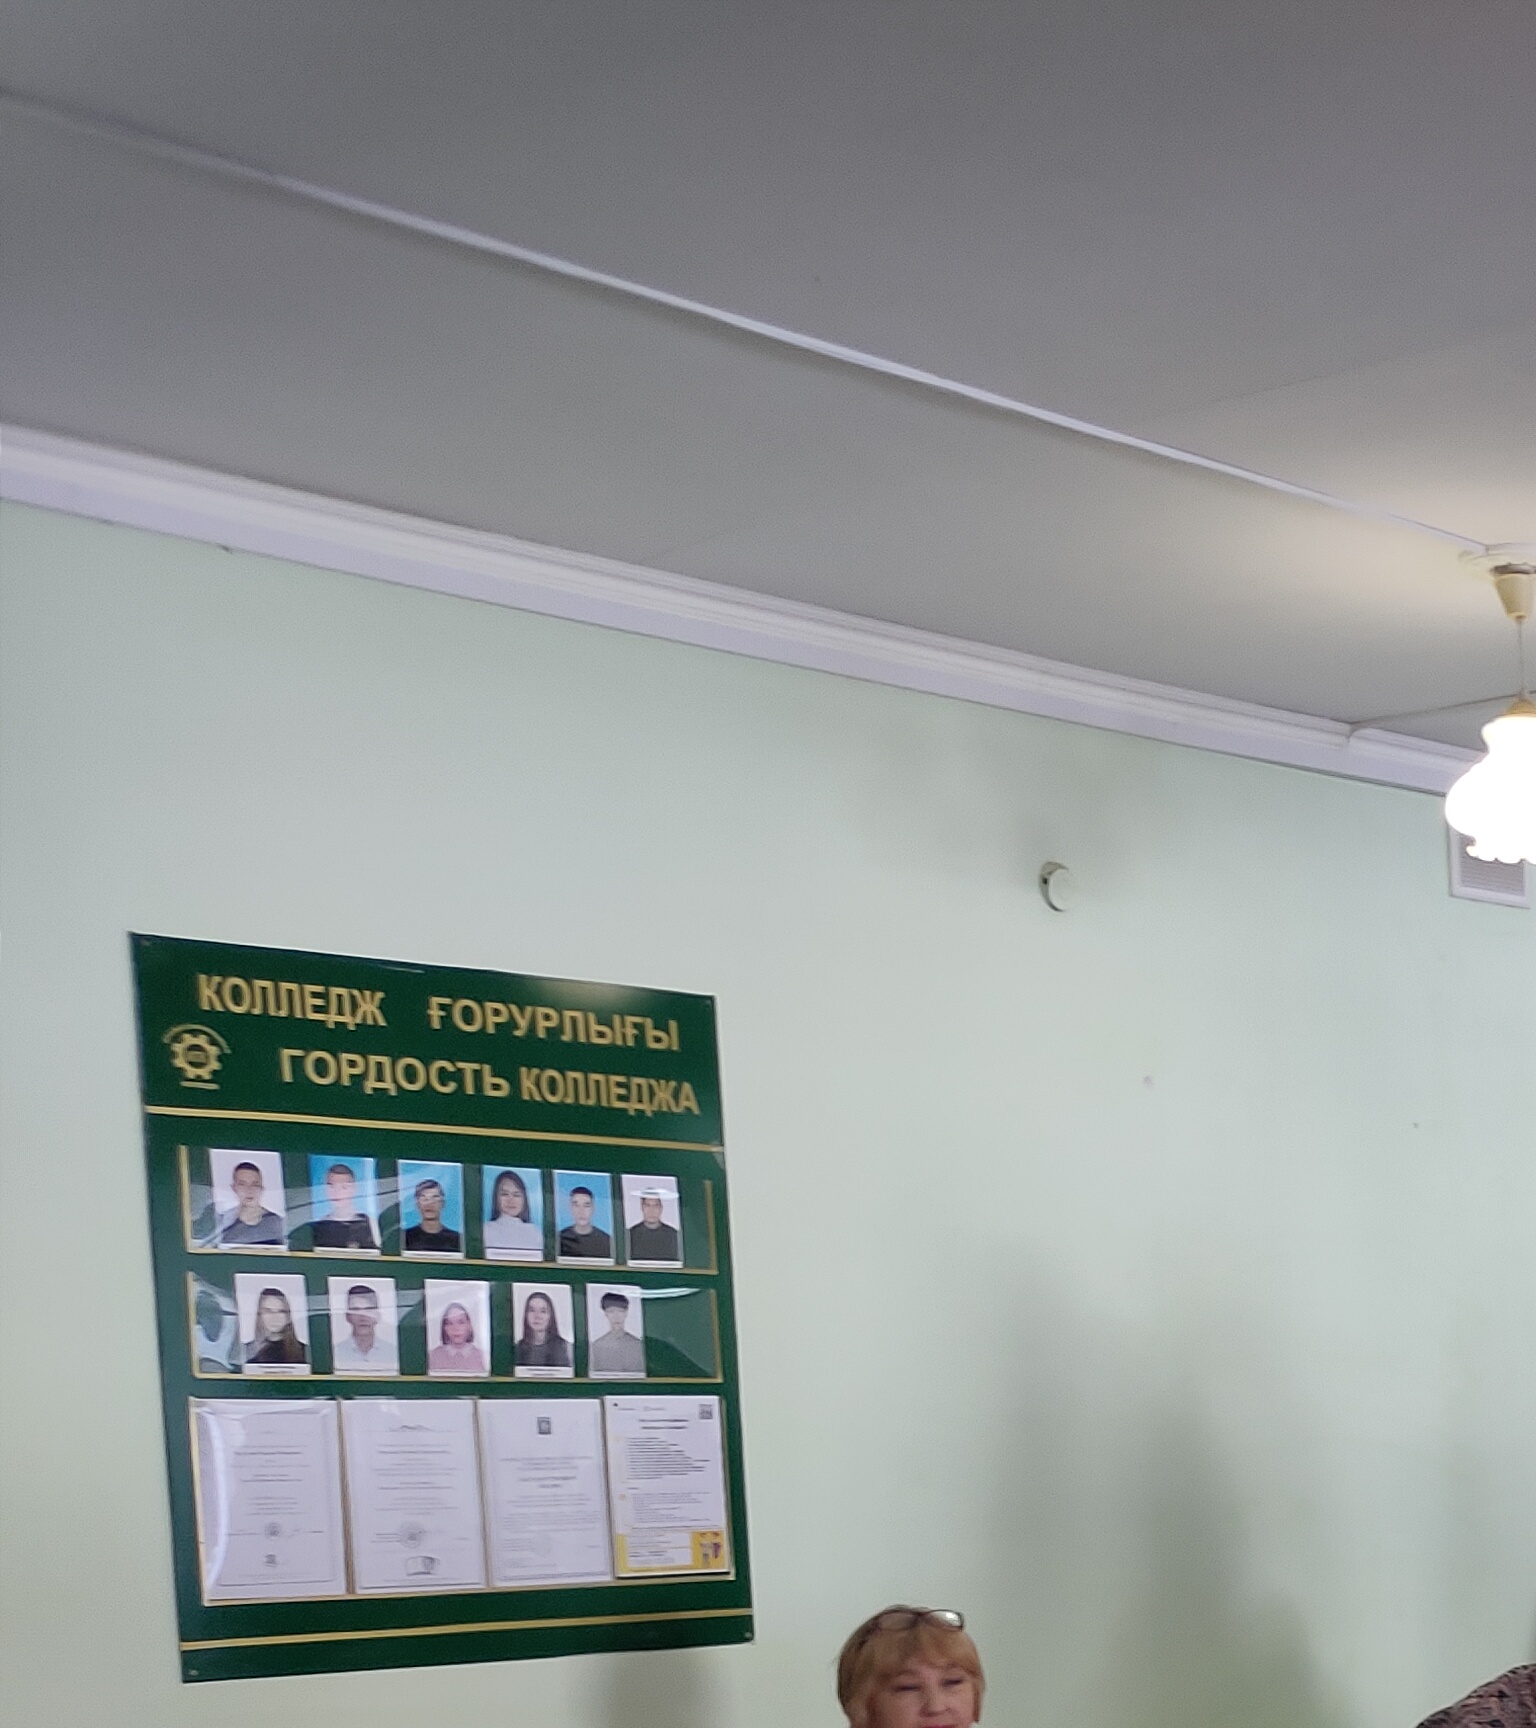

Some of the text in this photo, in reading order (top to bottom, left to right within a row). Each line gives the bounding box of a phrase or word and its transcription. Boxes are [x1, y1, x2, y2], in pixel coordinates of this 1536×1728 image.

[197, 973, 388, 1030] КОЛЛЕДЖ
[279, 1047, 702, 1117] ГОРДОСТЬ КОЛЛЕДЖА
